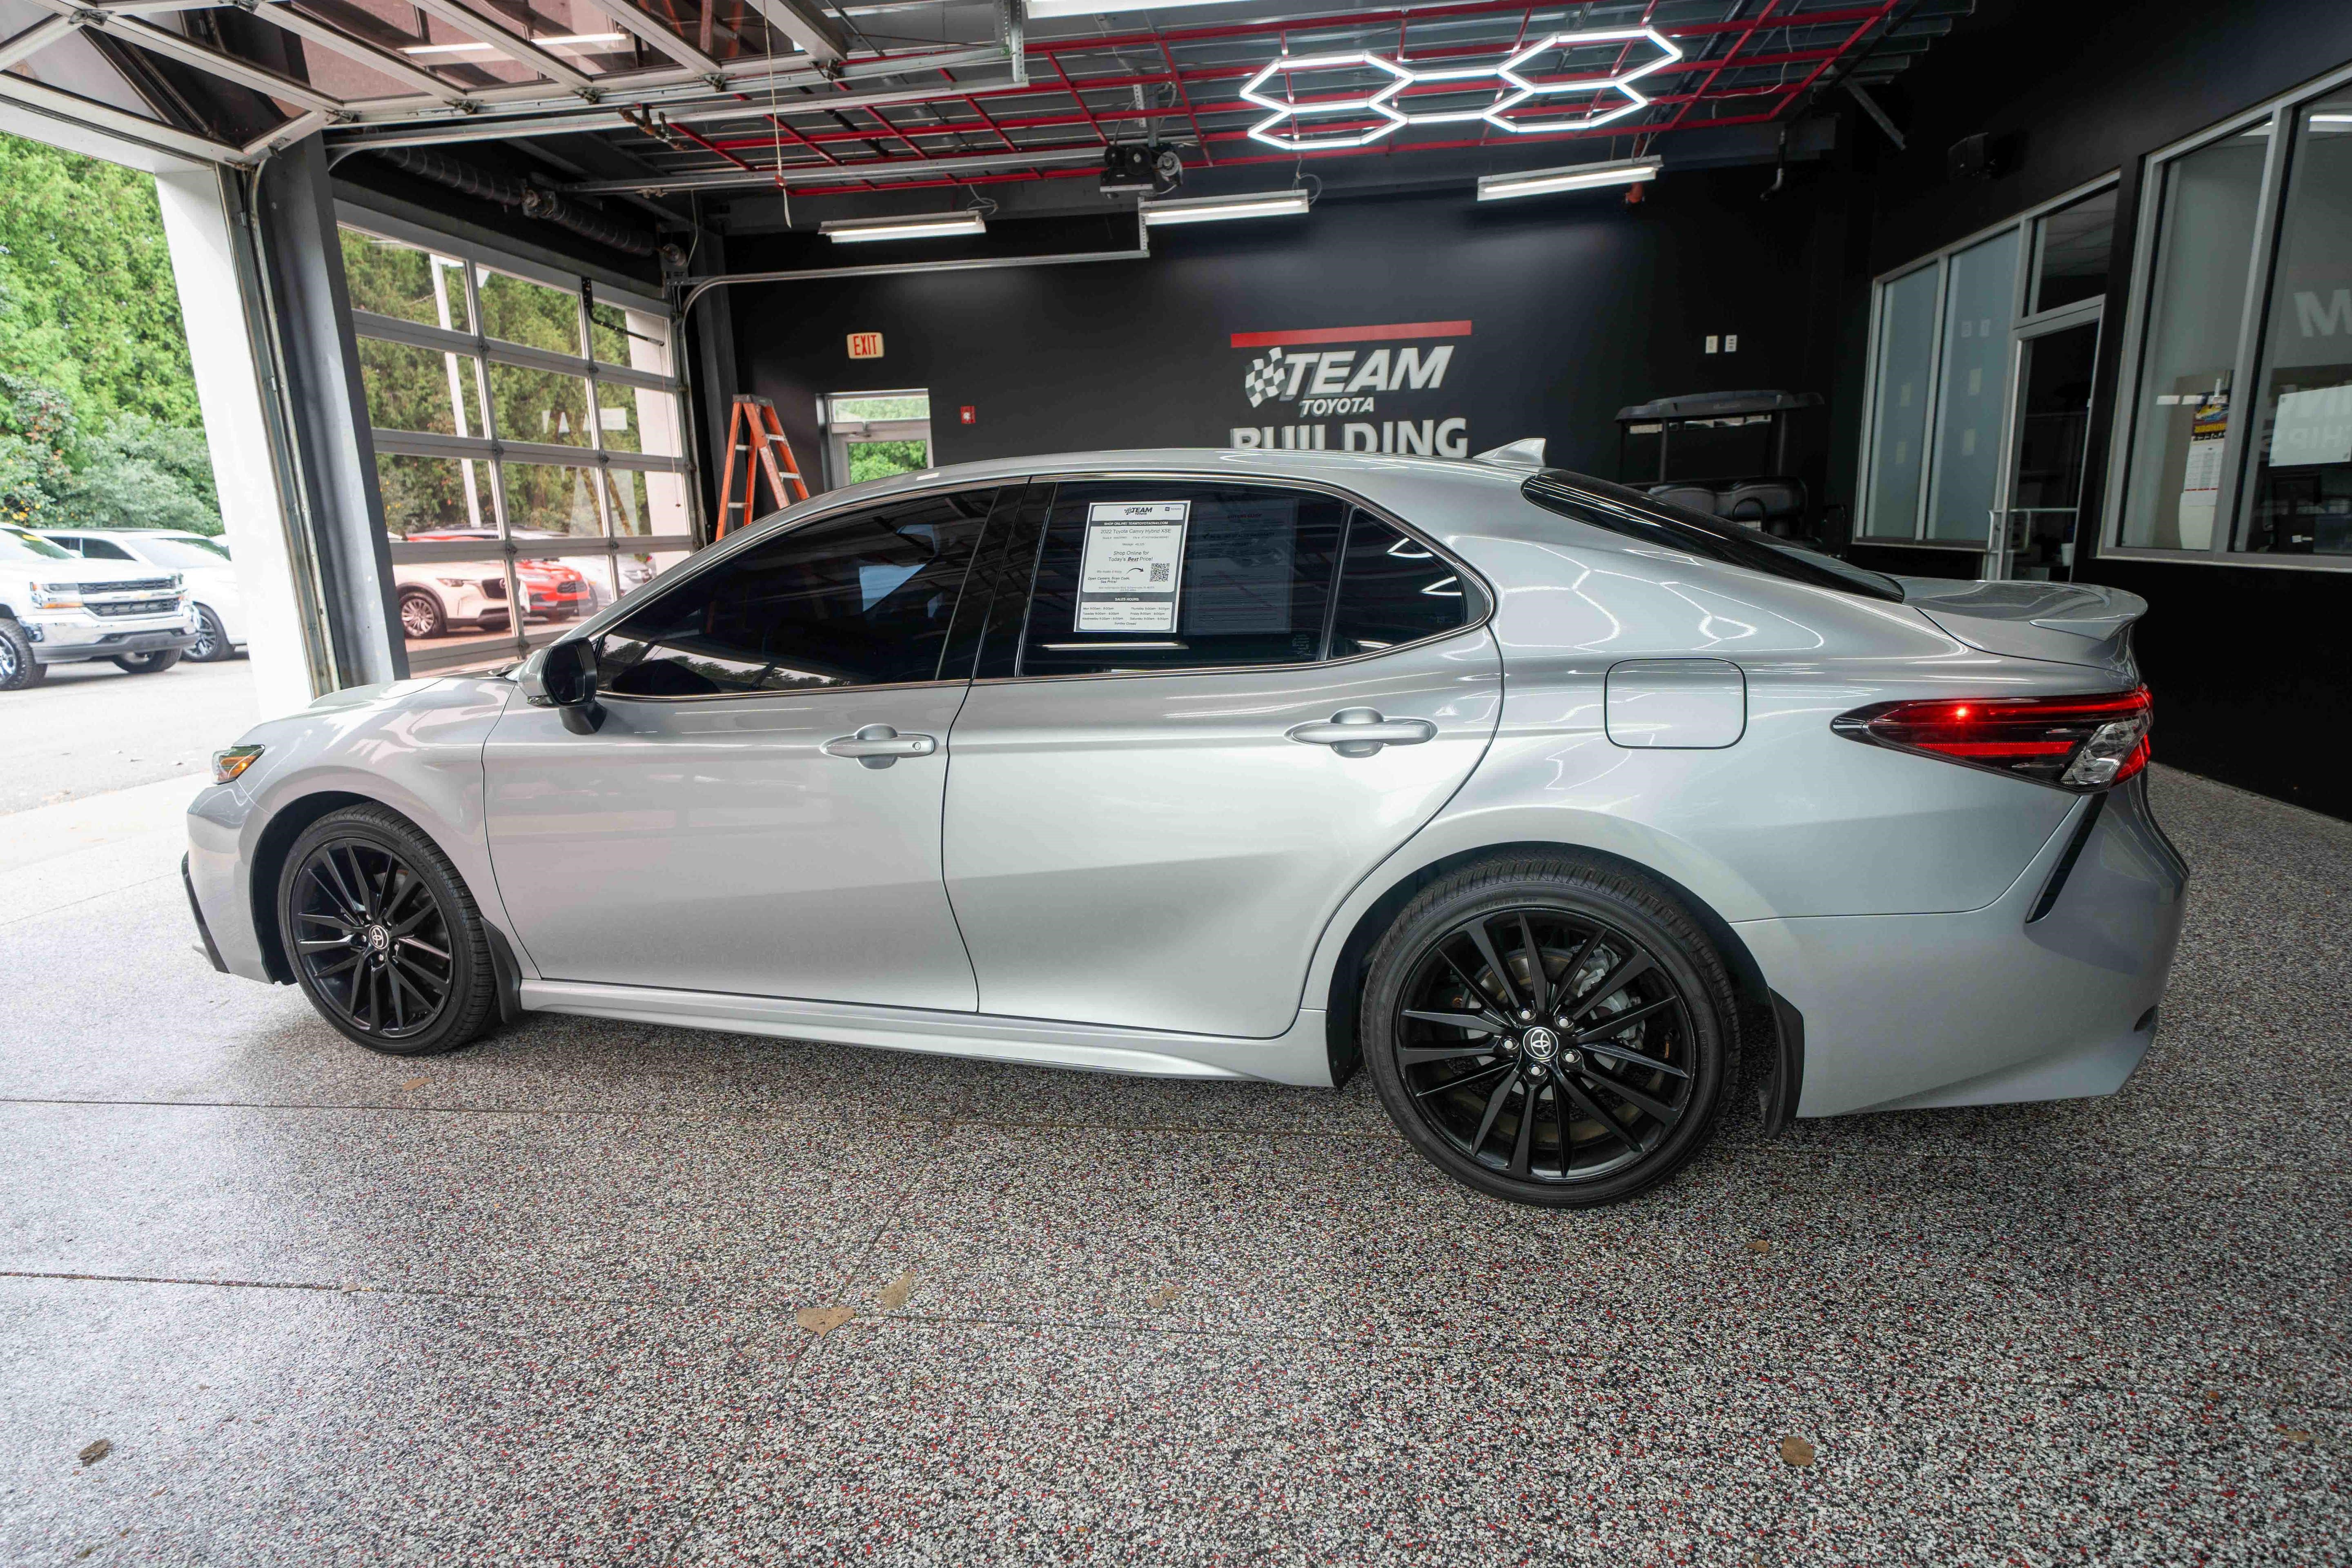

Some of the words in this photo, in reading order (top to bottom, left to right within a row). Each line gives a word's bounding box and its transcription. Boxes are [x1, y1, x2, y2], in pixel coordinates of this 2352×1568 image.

[853, 335, 876, 355] EXIT
[1285, 345, 1454, 396] TEAM
[1301, 397, 1374, 416] TOYOTA
